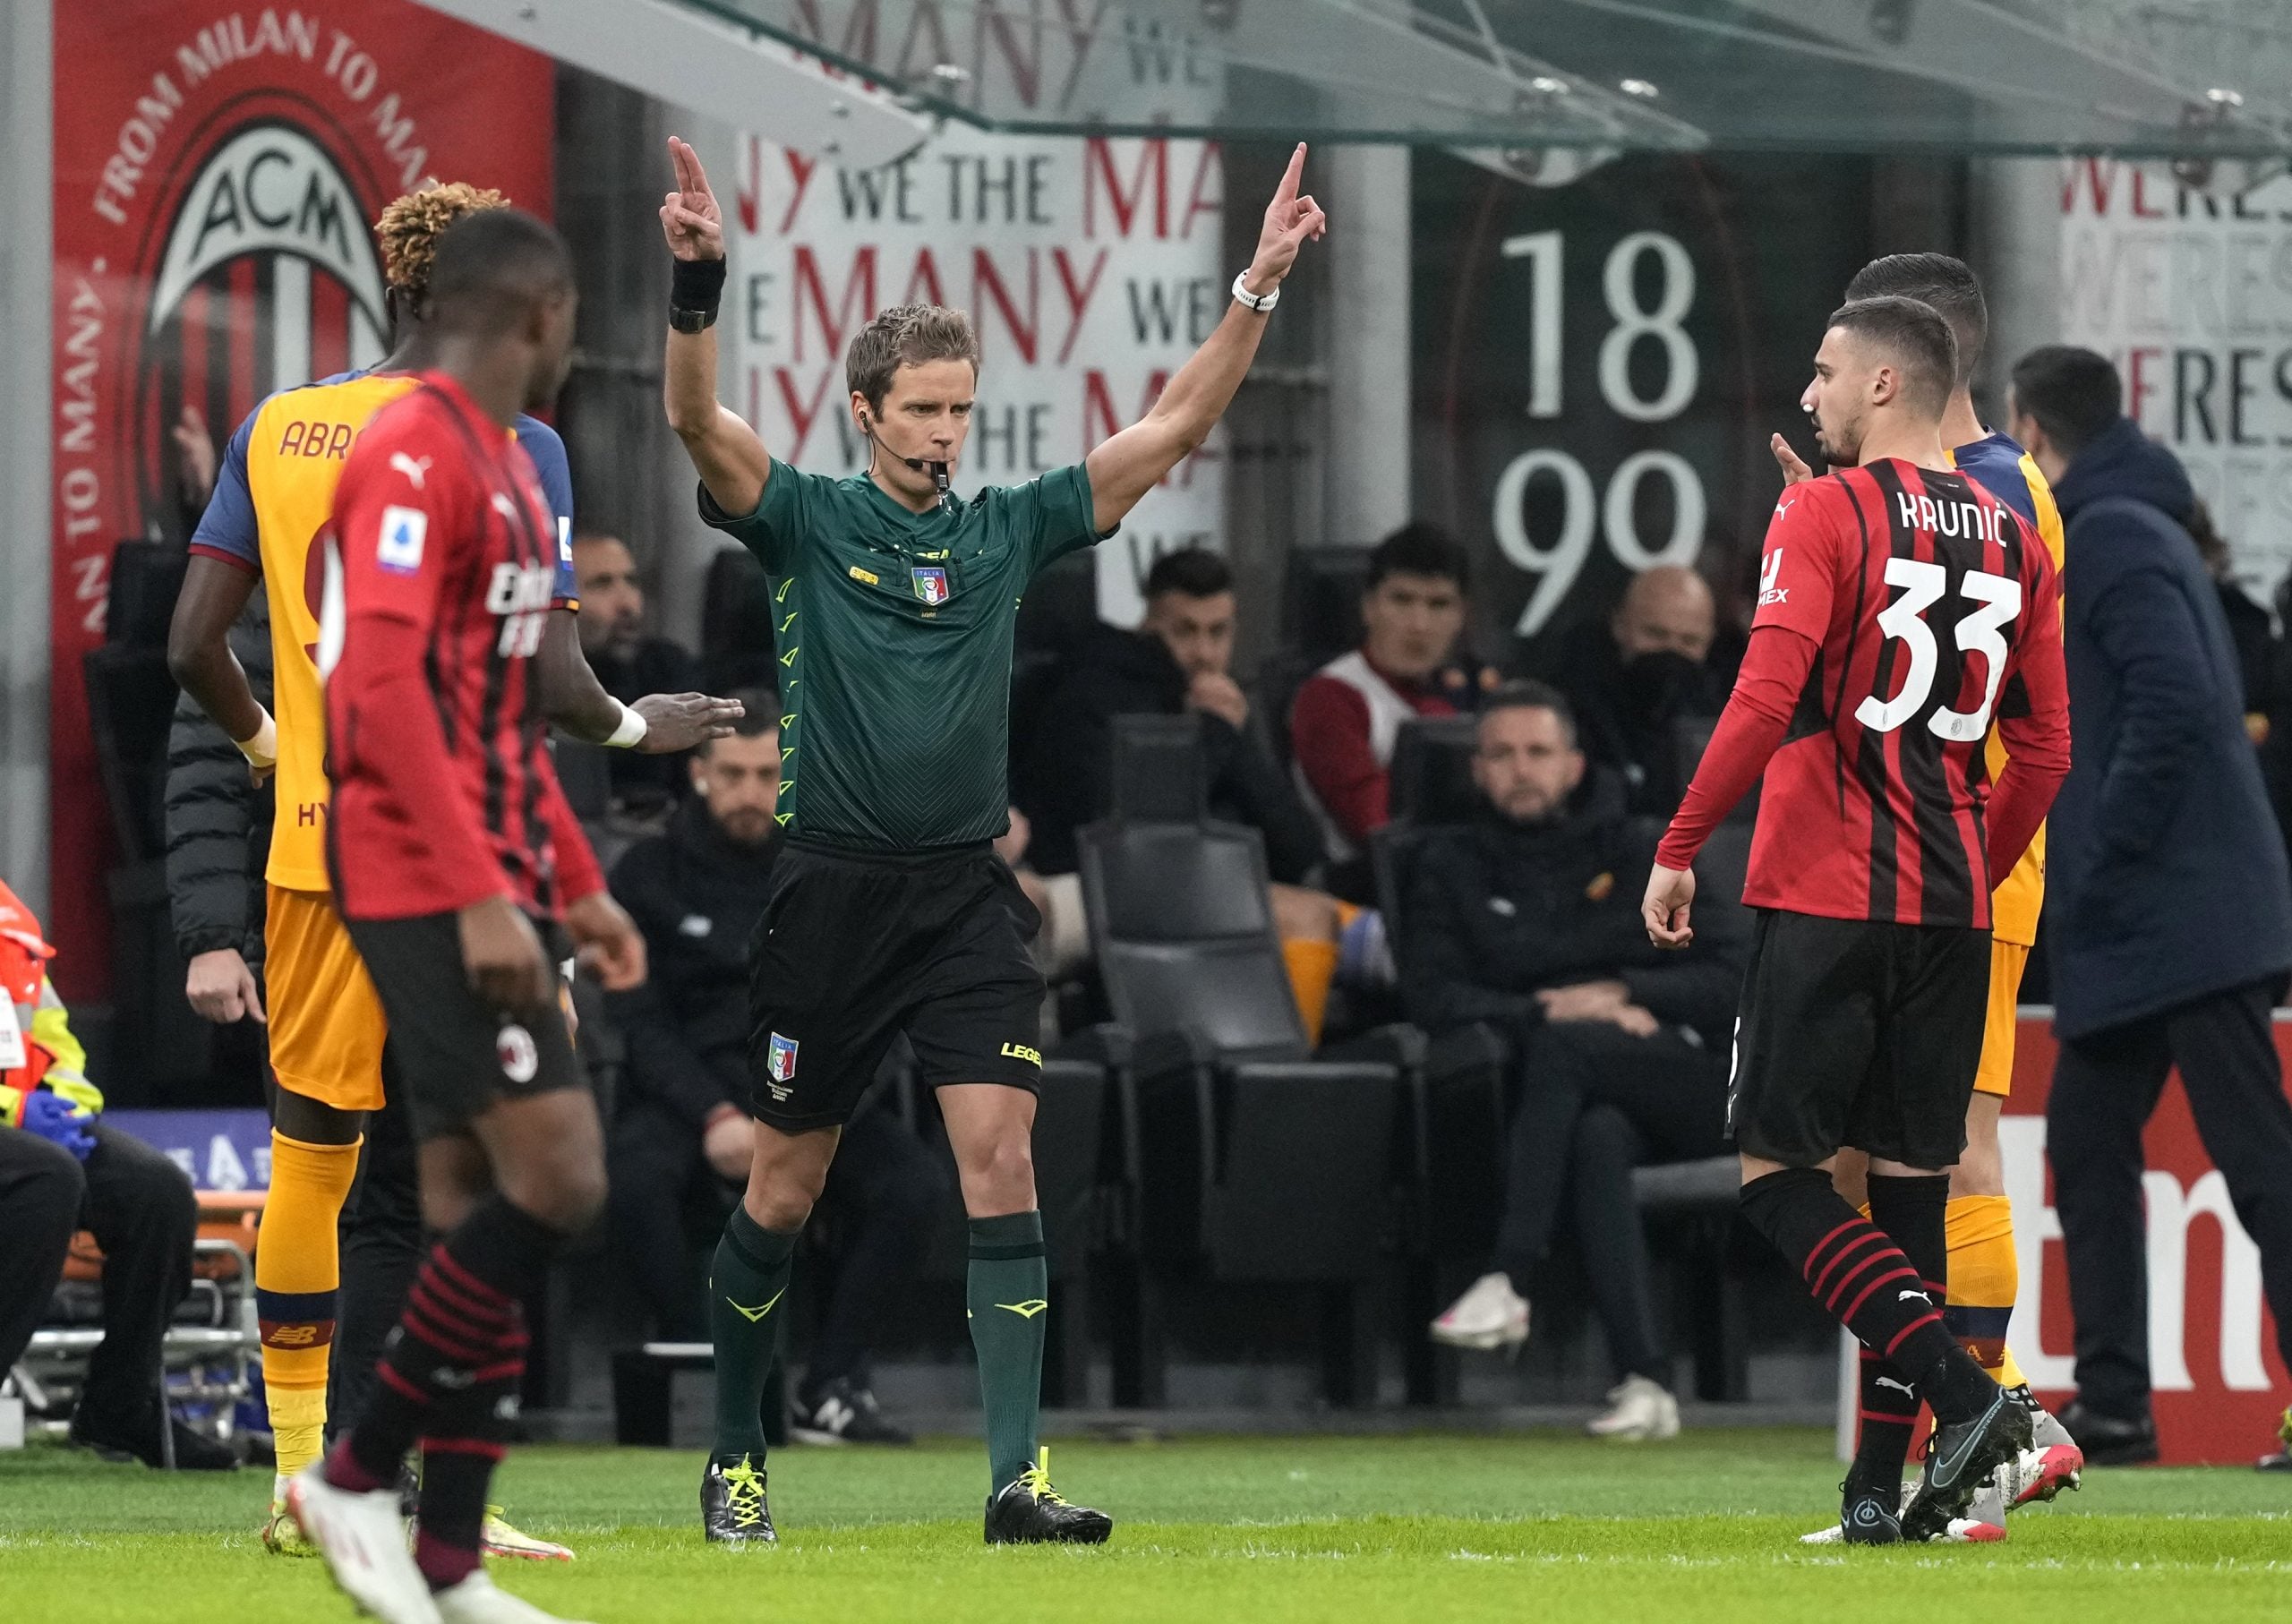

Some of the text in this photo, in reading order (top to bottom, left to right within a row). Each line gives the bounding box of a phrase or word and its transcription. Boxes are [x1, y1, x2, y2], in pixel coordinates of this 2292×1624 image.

[94, 72, 184, 226] FROM
[176, 9, 321, 87] MILAN
[325, 29, 379, 101] TO
[189, 147, 354, 268] ACM
[836, 158, 923, 222] WE
[940, 153, 1055, 224] THE
[1125, 276, 1217, 346] WE
[1501, 228, 1698, 422] 18
[63, 467, 102, 547] TO
[1853, 555, 2023, 742] 33
